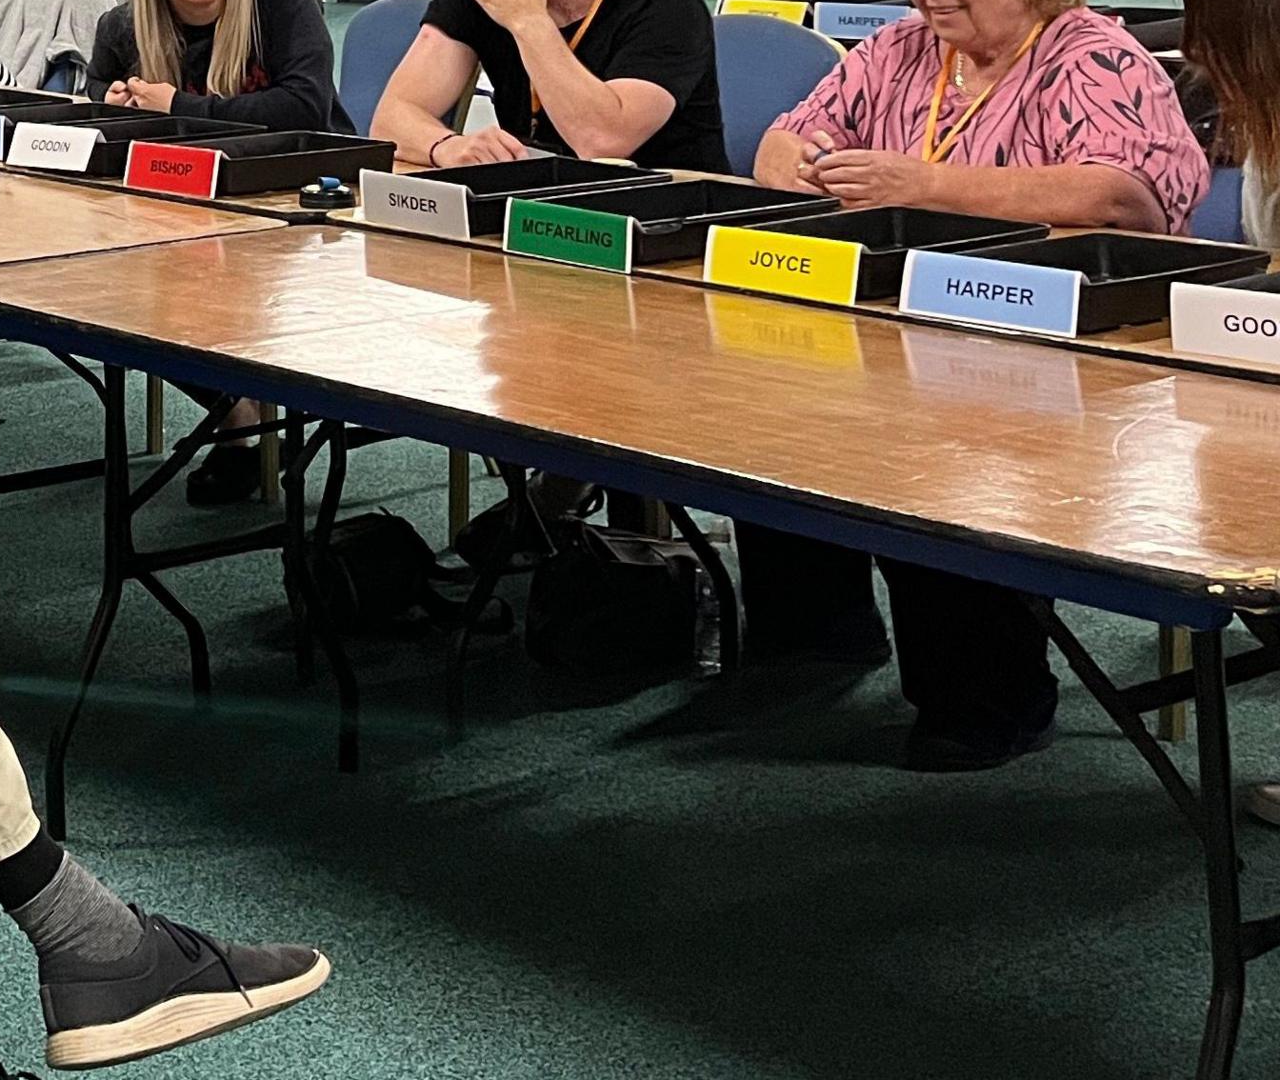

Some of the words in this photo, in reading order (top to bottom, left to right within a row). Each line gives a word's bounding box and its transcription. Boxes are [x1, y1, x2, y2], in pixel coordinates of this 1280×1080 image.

[838, 16, 886, 27] HARPER
[31, 139, 71, 152] GOODIN
[150, 159, 193, 176] BISHOP
[388, 192, 438, 214] SIKDER
[521, 218, 613, 248] MCFARLING
[749, 250, 812, 274] JOYCE
[946, 277, 1034, 306] HARPER
